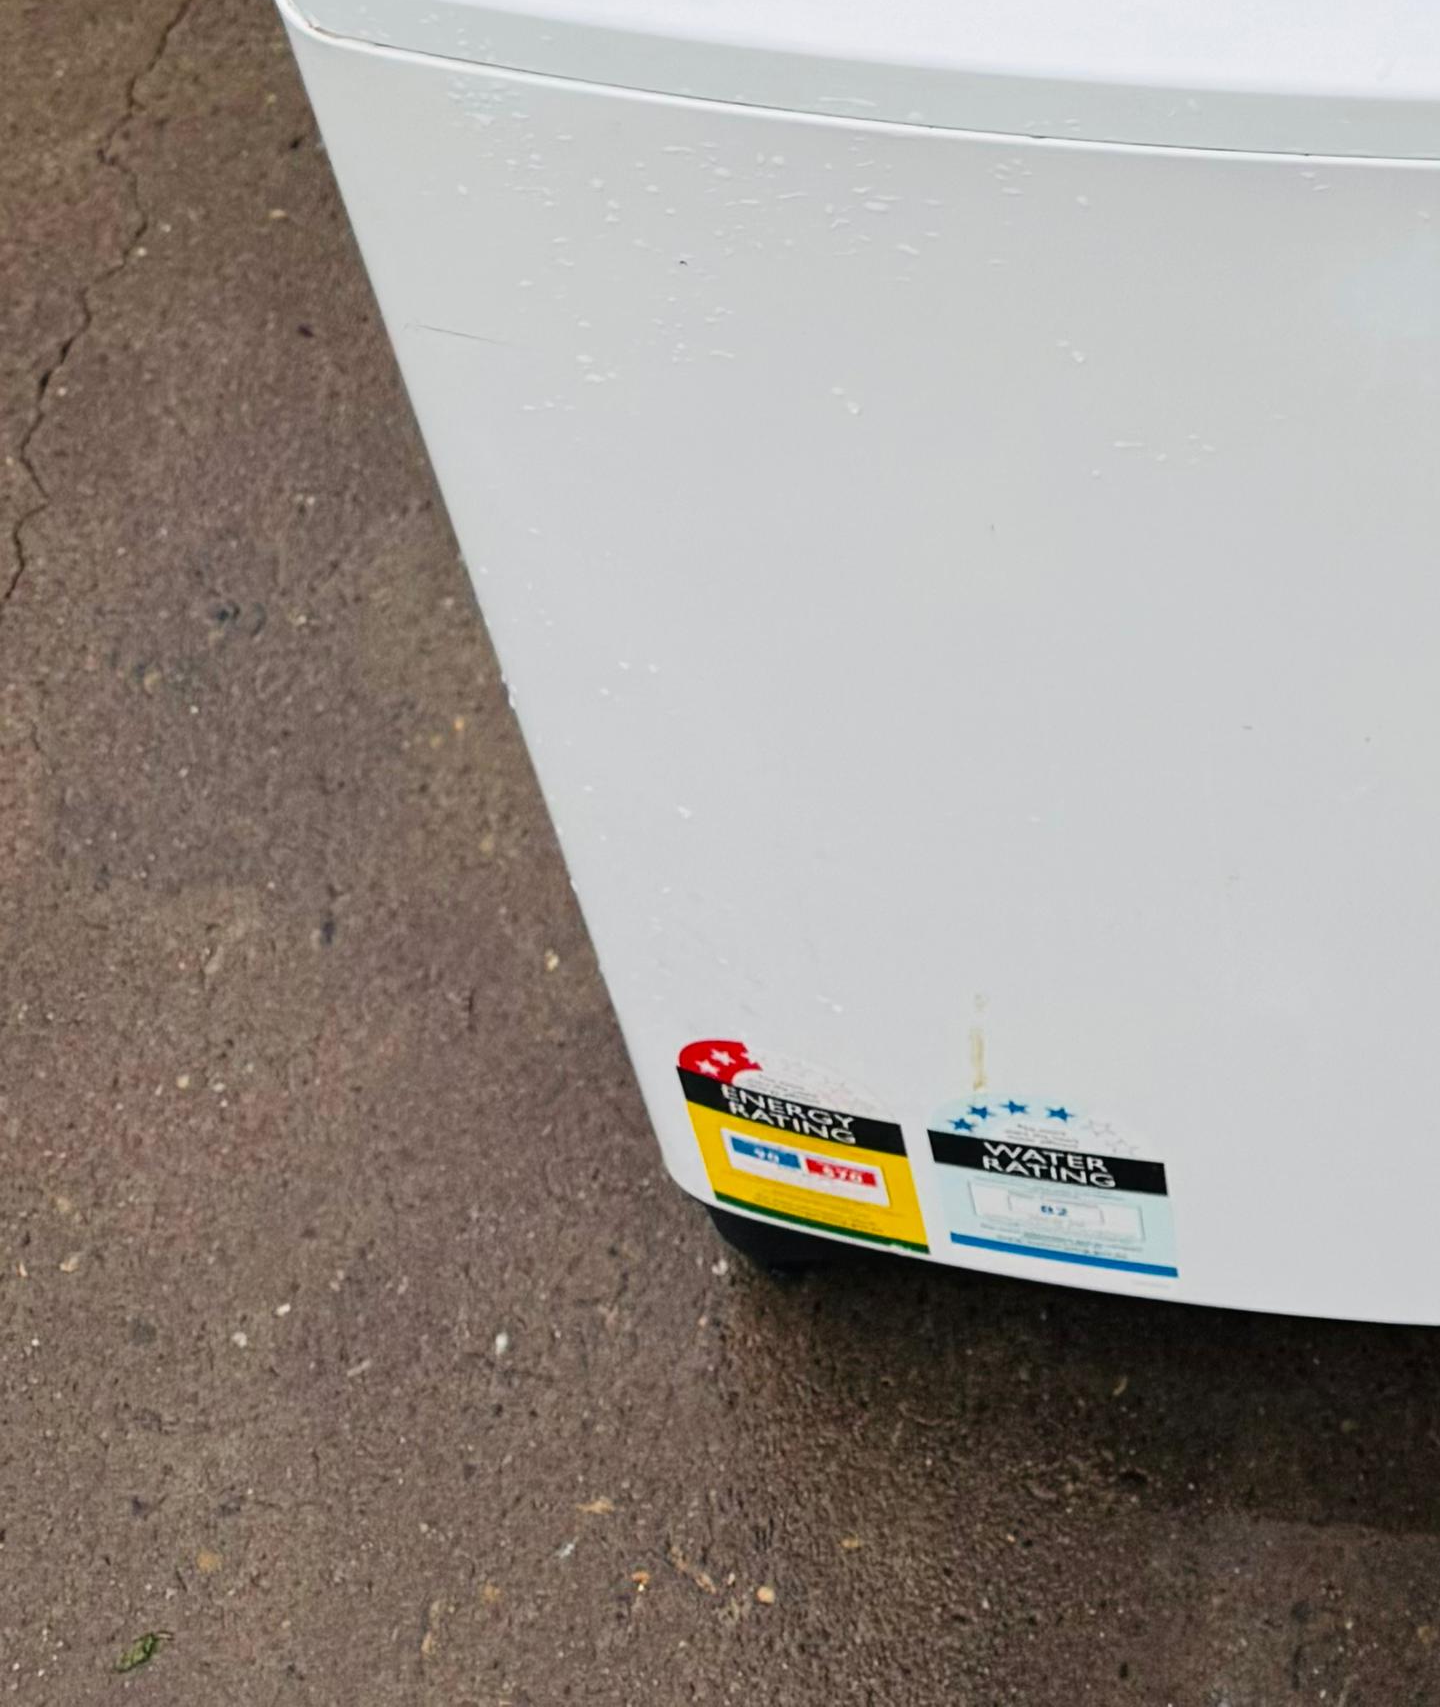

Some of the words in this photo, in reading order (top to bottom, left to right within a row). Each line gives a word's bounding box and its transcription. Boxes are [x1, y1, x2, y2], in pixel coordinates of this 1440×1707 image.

[721, 1084, 854, 1129] ENERGY
[729, 1102, 857, 1144] RATING
[982, 1155, 1117, 1188] RATING
[983, 1141, 1108, 1173] WATER
